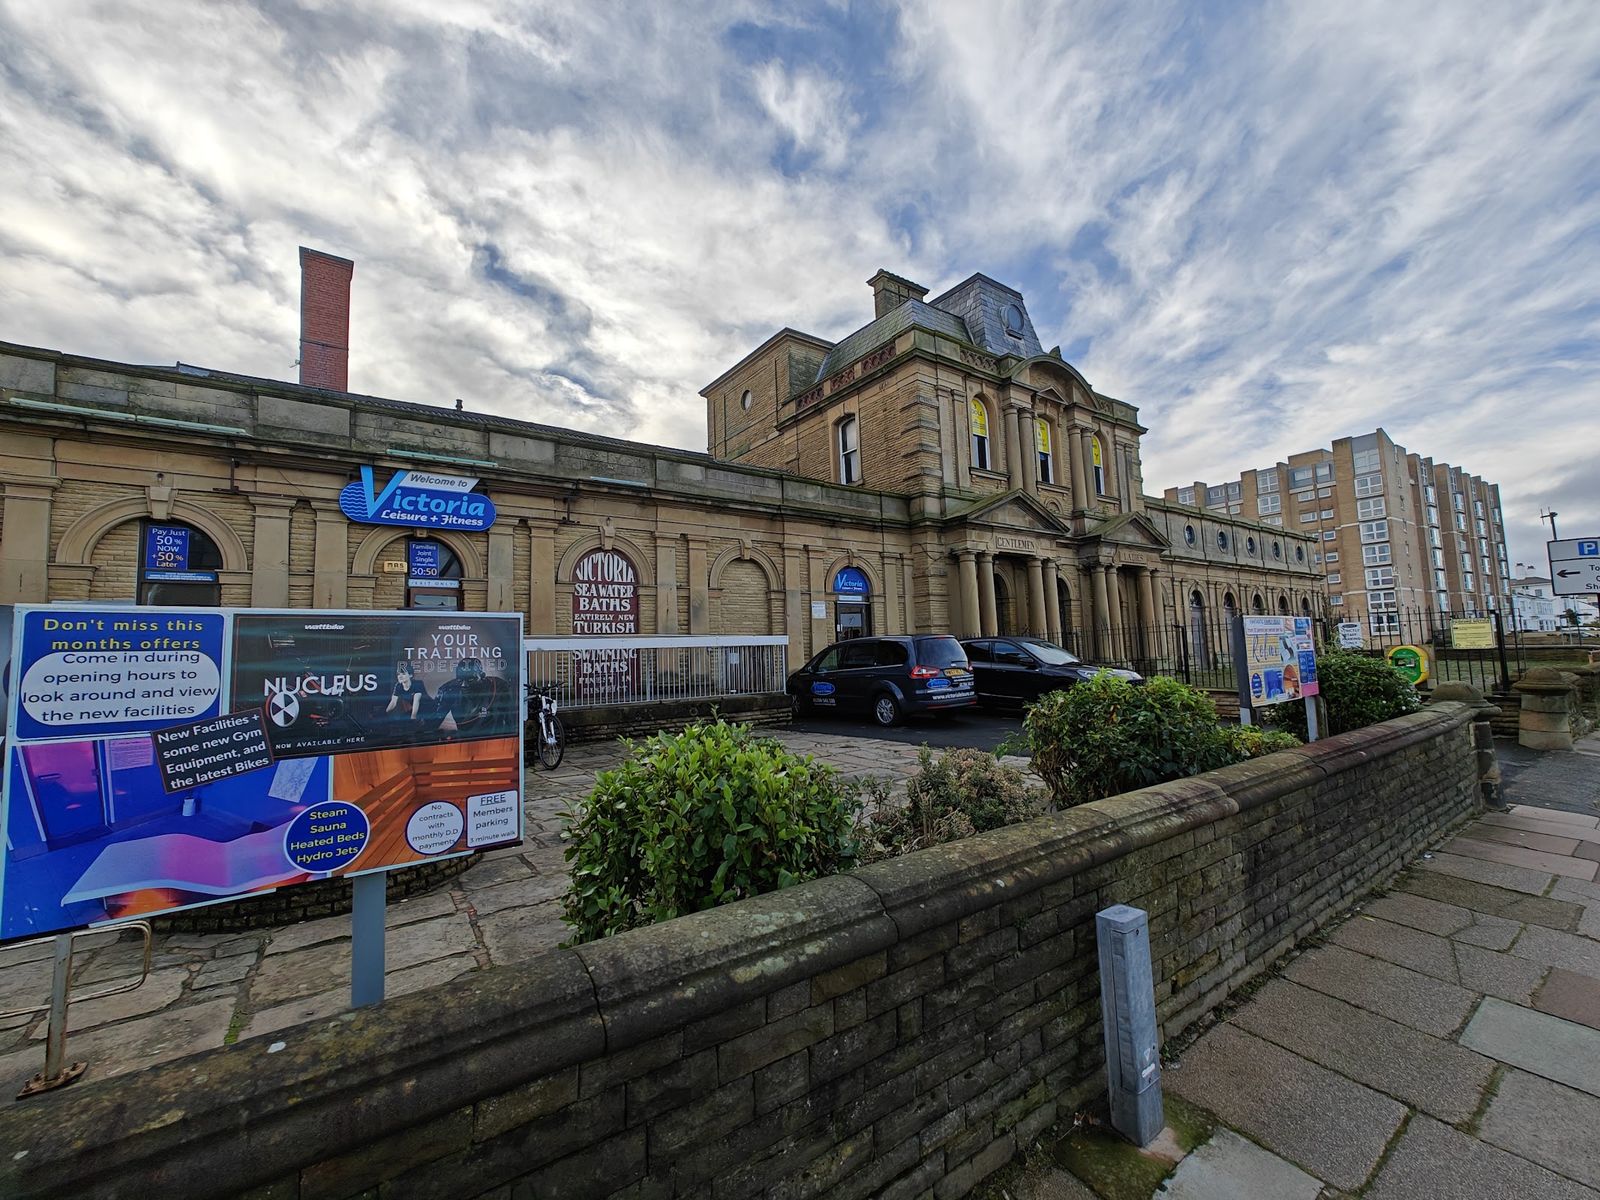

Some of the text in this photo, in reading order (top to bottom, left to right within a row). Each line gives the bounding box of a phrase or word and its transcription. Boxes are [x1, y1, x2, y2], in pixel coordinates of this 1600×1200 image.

[410, 473, 468, 488] Welcome to
[360, 465, 485, 518] Victoria
[381, 509, 484, 527] Leisure + Fitness
[152, 528, 186, 537] Pay Just
[997, 536, 1035, 550] GENTLEMEN
[1582, 542, 1596, 555] P
[415, 556, 434, 564] Single
[411, 567, 438, 576] 50:50
[575, 552, 636, 583] VICTORIA
[837, 573, 863, 589] Victoria
[579, 597, 631, 612] BATHS
[574, 613, 614, 621] ENTIRELY
[43, 618, 204, 631] Don't miss this
[573, 621, 636, 634] TURKISH
[52, 638, 200, 650] months offers
[431, 633, 479, 646] YOUR
[62, 651, 200, 664] Come in during
[404, 646, 502, 659] TRAINING
[397, 658, 508, 674] REDEFINED
[583, 661, 628, 674] BATHS
[43, 669, 197, 685] opening hours to
[264, 674, 378, 697] NUCLEUS
[23, 685, 217, 704] look around and view
[42, 704, 195, 722] the new facilities
[157, 730, 190, 743] New
[192, 716, 250, 736] Facilities
[162, 729, 263, 759] some new Gym
[296, 738, 342, 748] AVAILABLE
[166, 741, 266, 774] Equipment, and
[170, 757, 269, 789] the latest Bikes
[480, 793, 506, 805] FREE
[309, 808, 348, 820] Steam
[419, 812, 454, 822] contracts
[473, 806, 513, 818] Members
[310, 822, 347, 834] Sauna
[428, 822, 445, 830] with
[475, 817, 509, 830] parking
[290, 831, 365, 851] Heated Beds
[412, 831, 443, 843] monthly
[475, 833, 499, 843] minute
[501, 830, 516, 838] walk
[419, 838, 456, 850] payments
[297, 846, 359, 864] Hydro Jets
